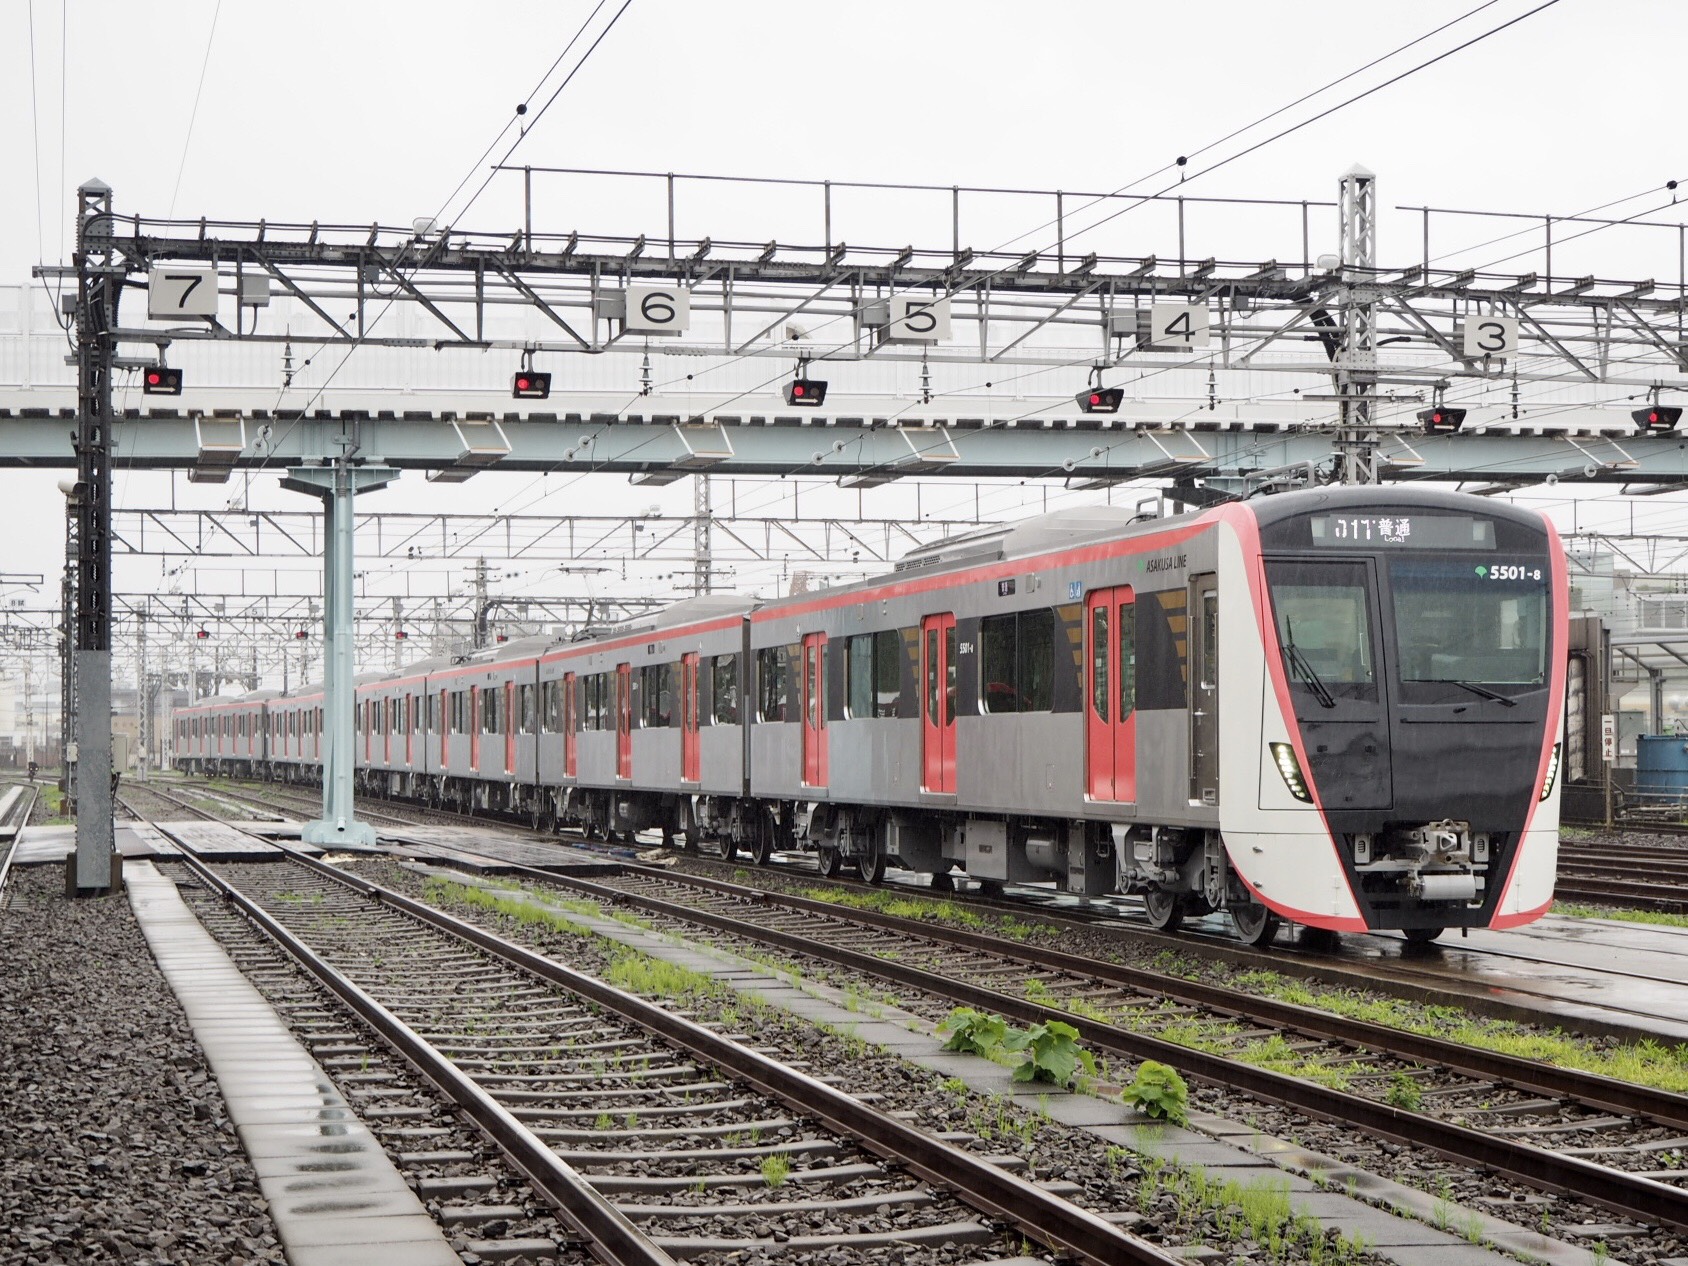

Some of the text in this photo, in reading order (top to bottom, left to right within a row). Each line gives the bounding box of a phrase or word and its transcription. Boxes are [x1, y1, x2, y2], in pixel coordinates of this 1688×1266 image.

[165, 275, 202, 308] 7
[641, 292, 675, 323] 6
[904, 302, 936, 332] 5
[1165, 312, 1195, 342] 4
[1477, 322, 1506, 351] 3
[1378, 518, 1411, 536] 普通
[1145, 554, 1187, 573] ASAKUSA LINE
[1489, 565, 1541, 580] 5501-8
